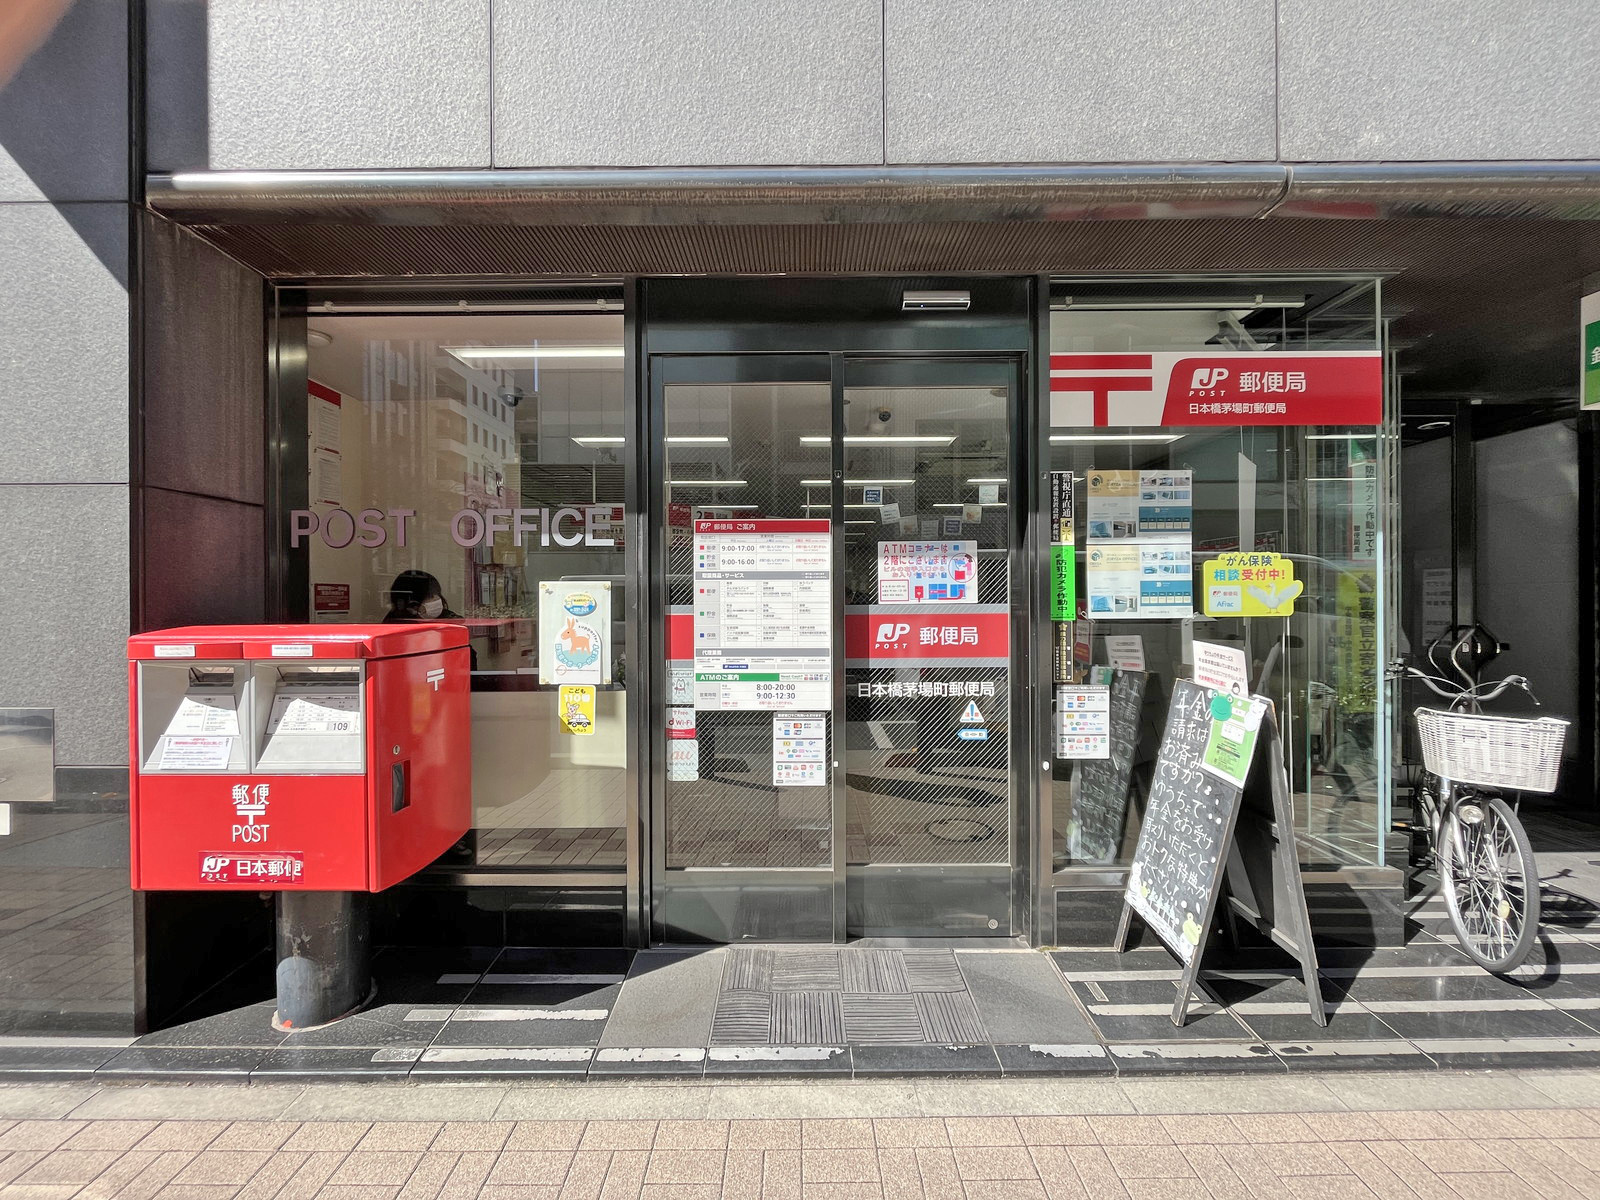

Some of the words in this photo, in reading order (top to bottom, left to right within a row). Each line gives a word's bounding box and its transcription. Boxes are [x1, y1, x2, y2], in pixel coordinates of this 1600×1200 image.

[1190, 367, 1229, 389] JP
[1239, 371, 1306, 393] 郵便局
[1188, 402, 1287, 415] 日本橋茅場町郵便局
[1062, 473, 1071, 518] 警視庁直通
[290, 509, 416, 549] POST
[450, 507, 616, 549] OFFICE
[883, 543, 949, 554] ATMコーナーは
[883, 555, 949, 566] 2階にございます
[1056, 559, 1068, 612] 防犯カメラ作動中
[1213, 569, 1285, 581] 相談受付中!
[876, 623, 910, 642] JP
[919, 626, 979, 646] 郵便局
[756, 683, 796, 691] 8:00-20:00
[857, 681, 996, 698] 日本橋茅場町郵便局
[333, 722, 348, 731] 109
[1171, 718, 1208, 743] 請求は
[1164, 736, 1203, 769] お済み
[231, 783, 270, 806] 郵便
[1154, 779, 1207, 819] ゆうちょで
[231, 824, 270, 843] POST
[1149, 796, 1214, 850] 年金をお受け
[1144, 816, 1209, 877] 取りいただくと
[236, 860, 302, 877] 日本郵便
[1141, 834, 1212, 902] おトクな特典が
